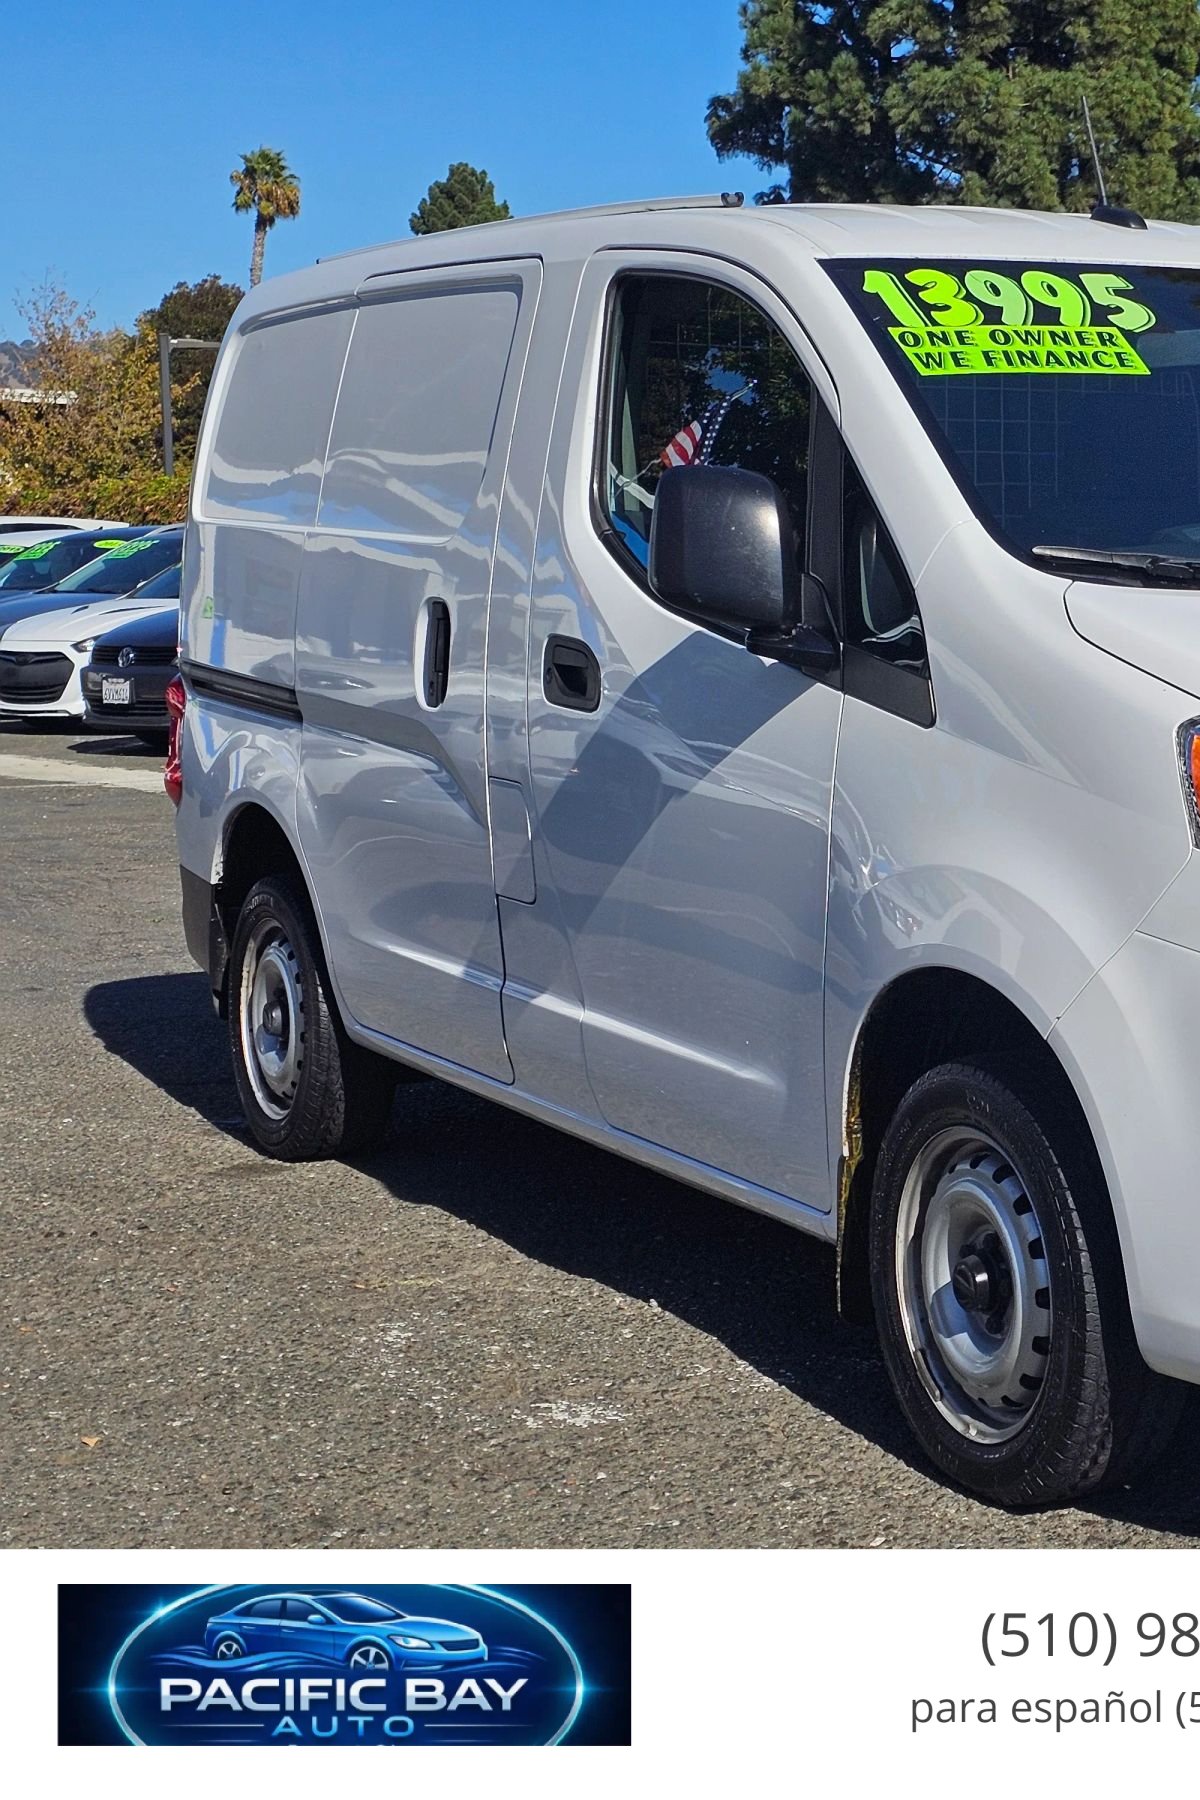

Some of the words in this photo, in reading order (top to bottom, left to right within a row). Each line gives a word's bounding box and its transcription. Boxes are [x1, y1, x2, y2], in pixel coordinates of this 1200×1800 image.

[862, 269, 1157, 333] 13995
[897, 330, 975, 349] ONE
[988, 329, 1119, 348] OWNER
[912, 351, 971, 369] WE
[979, 350, 1136, 369] FINANCE
